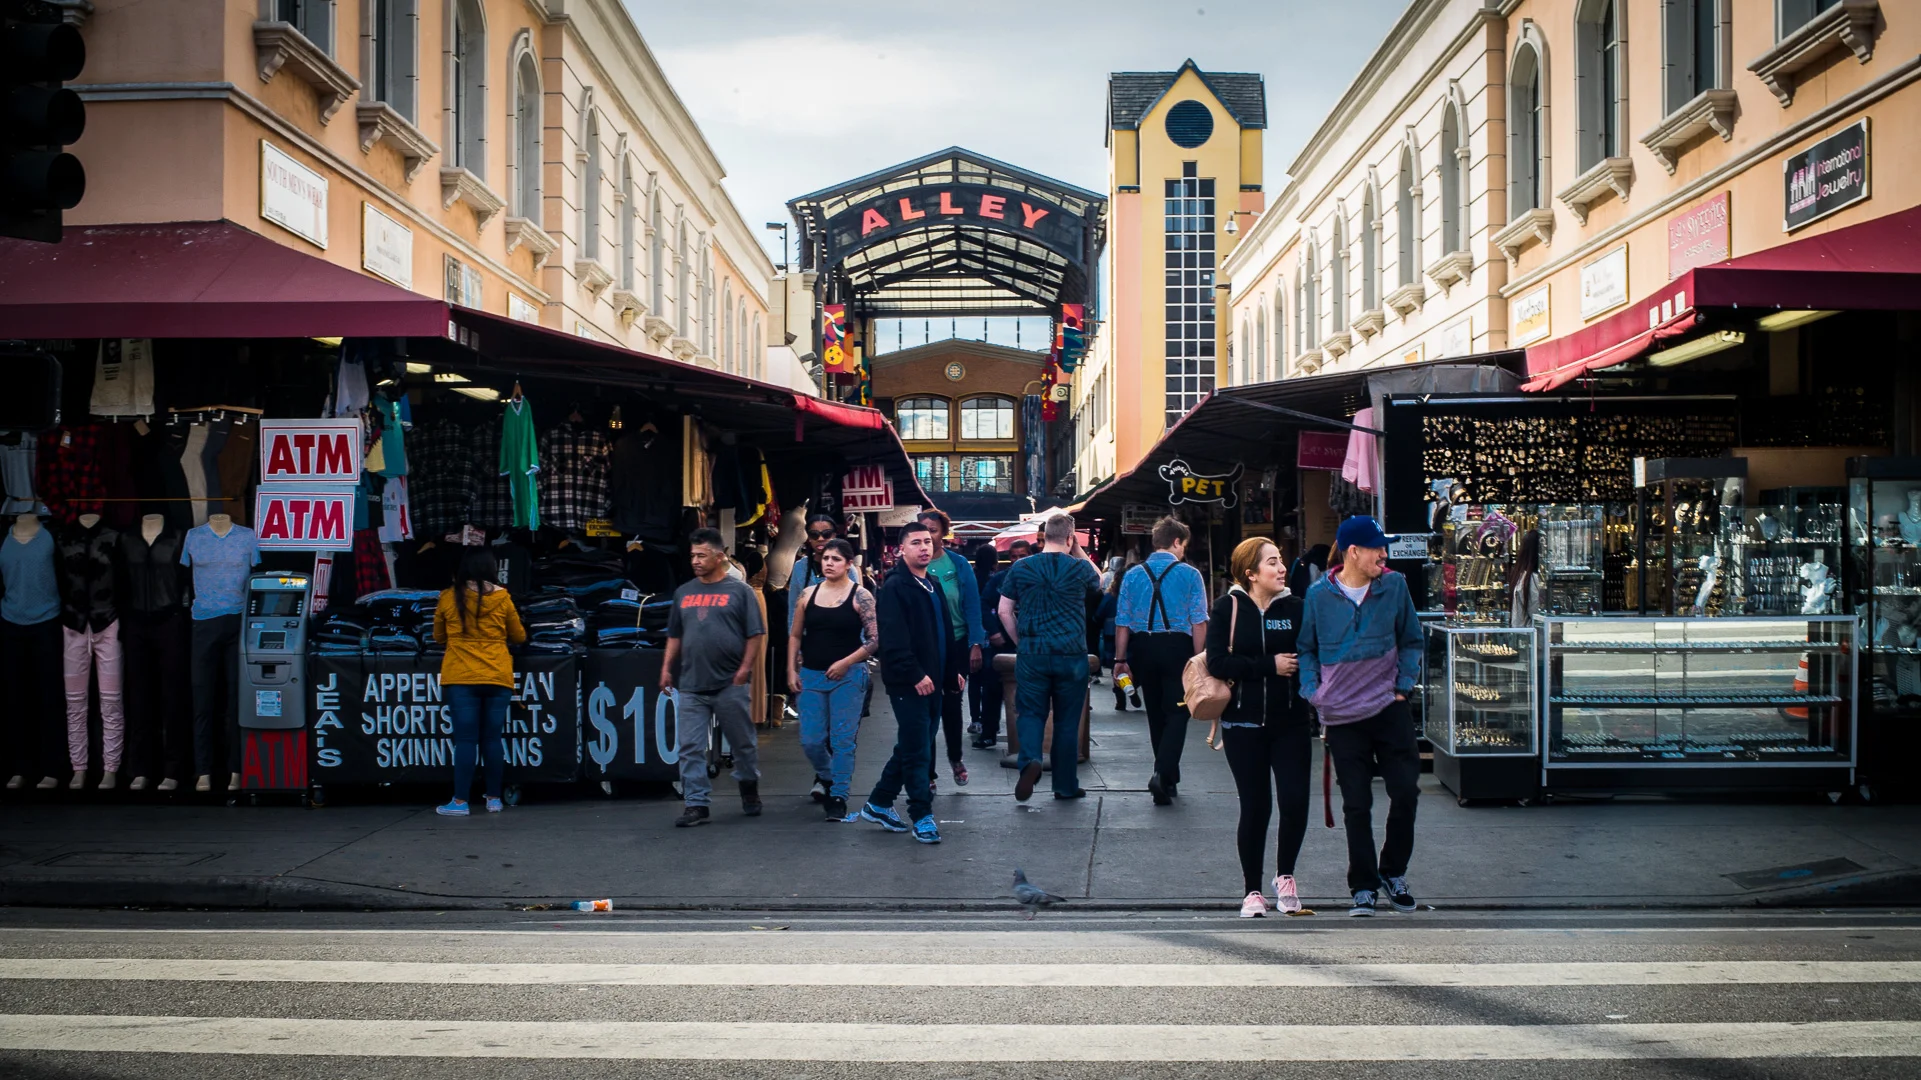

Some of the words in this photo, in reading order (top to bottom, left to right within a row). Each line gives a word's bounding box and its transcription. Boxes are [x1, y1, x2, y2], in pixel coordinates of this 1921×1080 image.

[266, 158, 287, 189] SOUTH
[1816, 138, 1863, 178] International
[1816, 168, 1862, 201] Jewelry
[861, 191, 1049, 236] ALLEY
[266, 433, 354, 475] ATM
[842, 466, 882, 490] TM
[1181, 477, 1225, 497] PET
[260, 499, 346, 540] ATM
[680, 593, 730, 609] GIANTS
[1265, 618, 1293, 630] GUESS
[587, 681, 680, 774] $10
[241, 731, 307, 789] ATM
[376, 738, 455, 768] SKINNY
